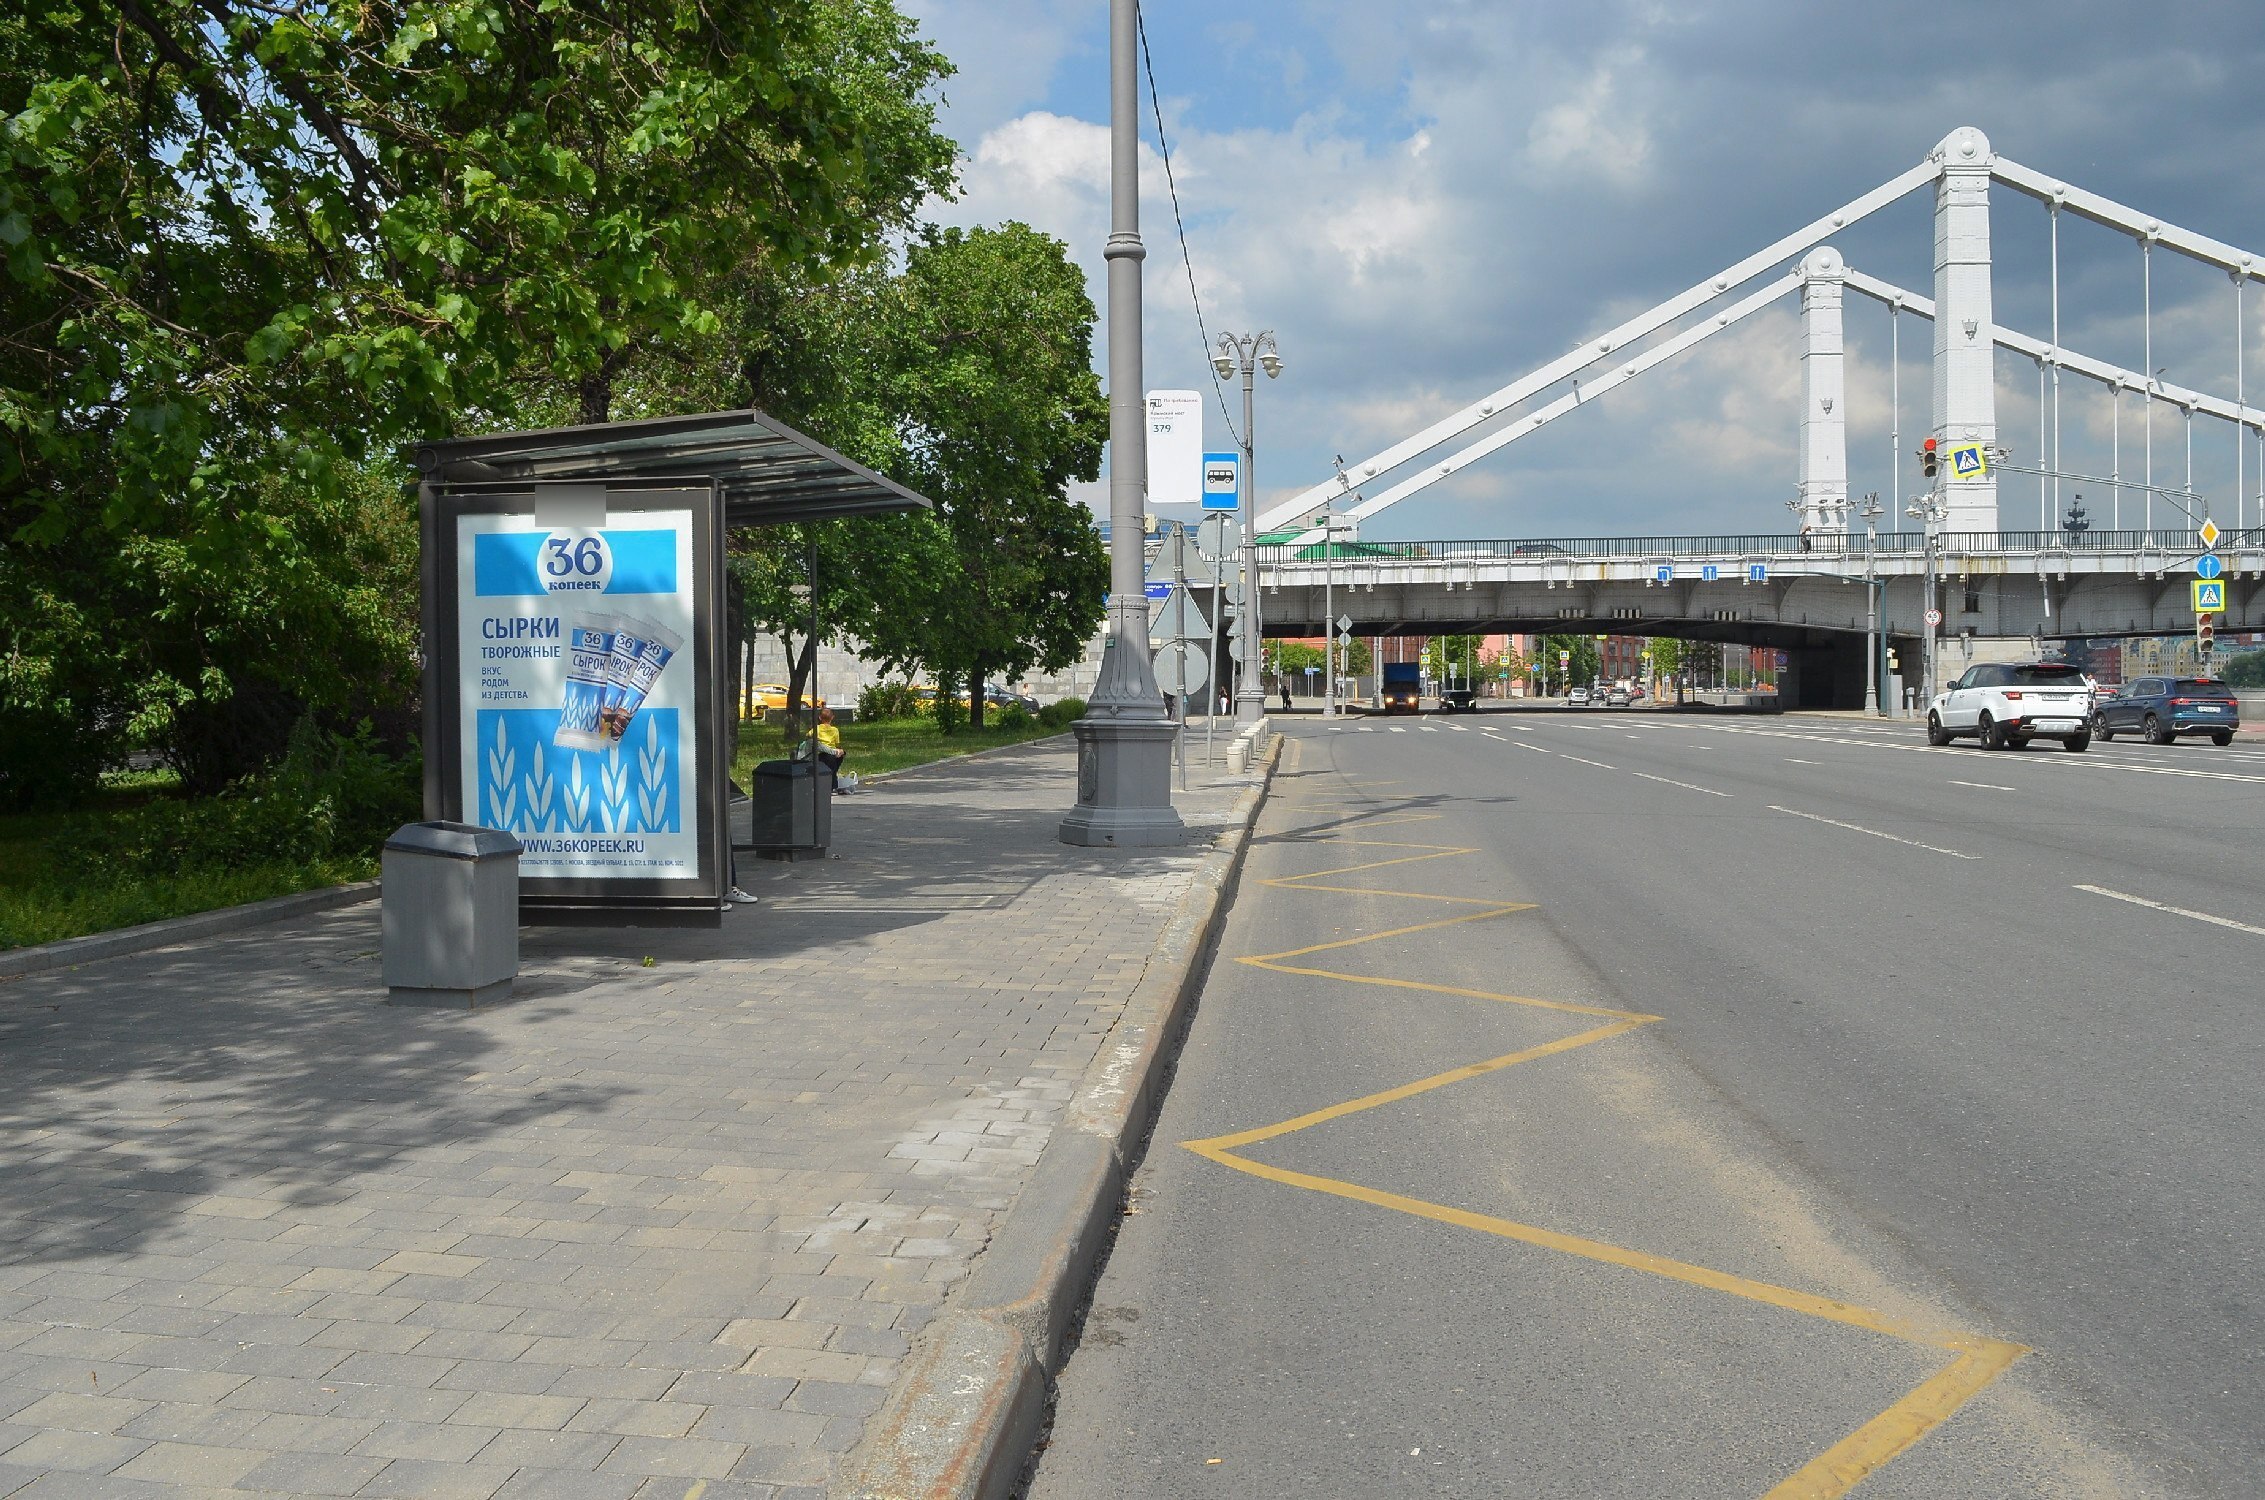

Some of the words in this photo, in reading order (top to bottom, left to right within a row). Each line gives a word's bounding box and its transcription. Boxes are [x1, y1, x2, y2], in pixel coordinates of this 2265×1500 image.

[1153, 424, 1171, 432] 379
[546, 537, 603, 576] 36
[548, 580, 602, 590] копеек
[482, 617, 560, 639] СЫРКИ
[584, 632, 602, 646] 36
[617, 635, 635, 649] 36
[481, 645, 561, 659] ТВОРОЖНЫЕ
[645, 639, 662, 656] 36
[572, 653, 607, 671] СЫРОК
[481, 666, 502, 675] ВКУС
[481, 678, 509, 688] РОДОМ
[481, 691, 492, 699] ИЗ
[493, 690, 529, 700] ДЕТСТВА
